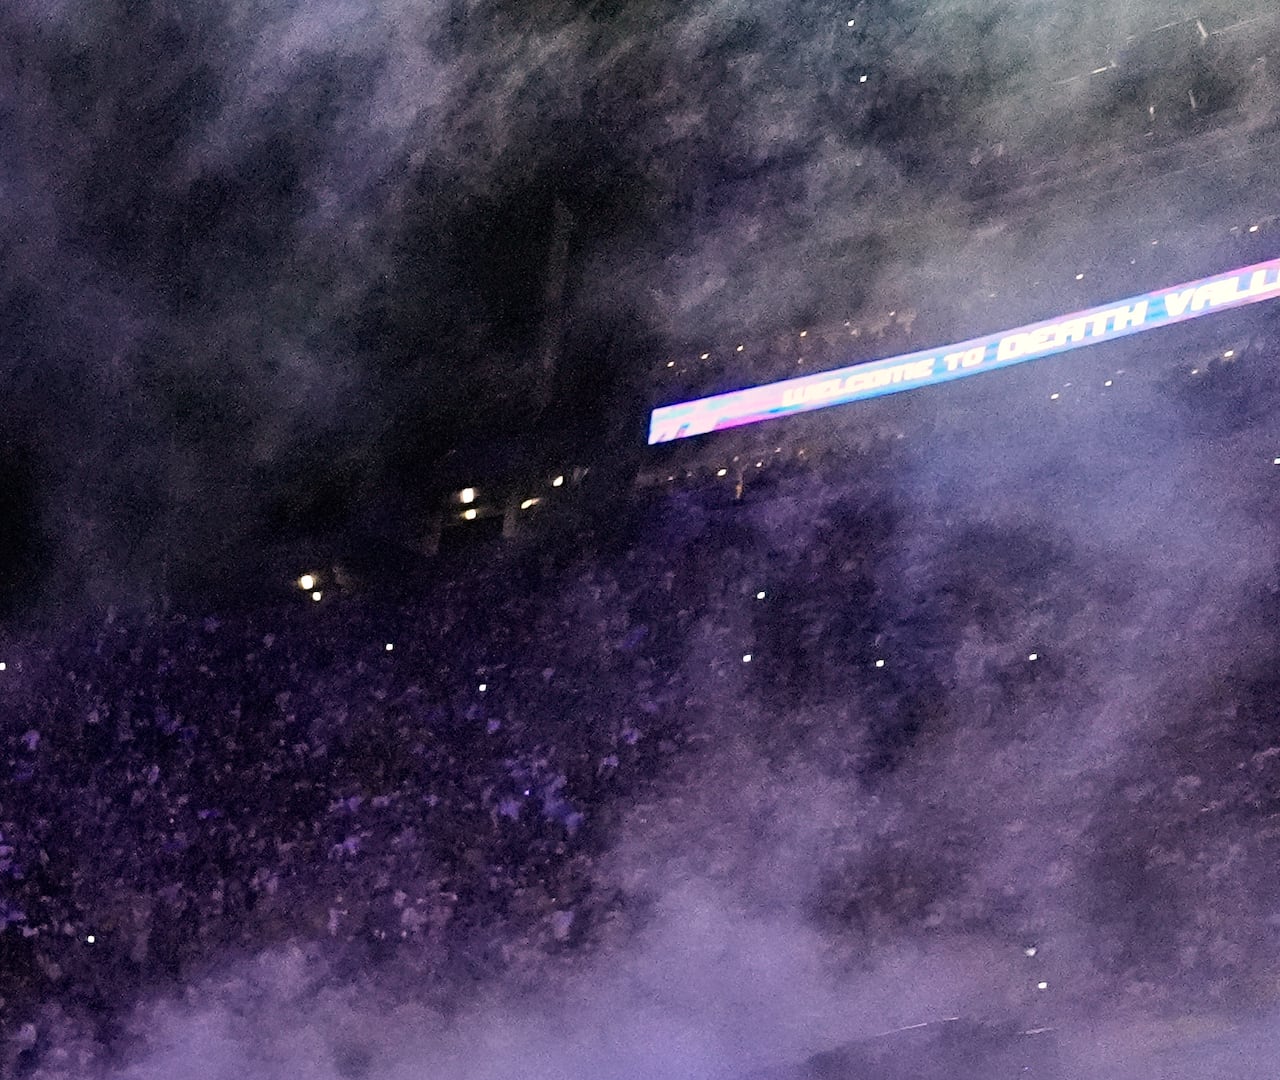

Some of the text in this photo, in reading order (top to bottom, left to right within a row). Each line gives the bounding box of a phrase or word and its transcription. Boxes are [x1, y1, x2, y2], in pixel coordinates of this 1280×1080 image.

[781, 268, 1280, 407] WELCOME TO DEATH VALL
